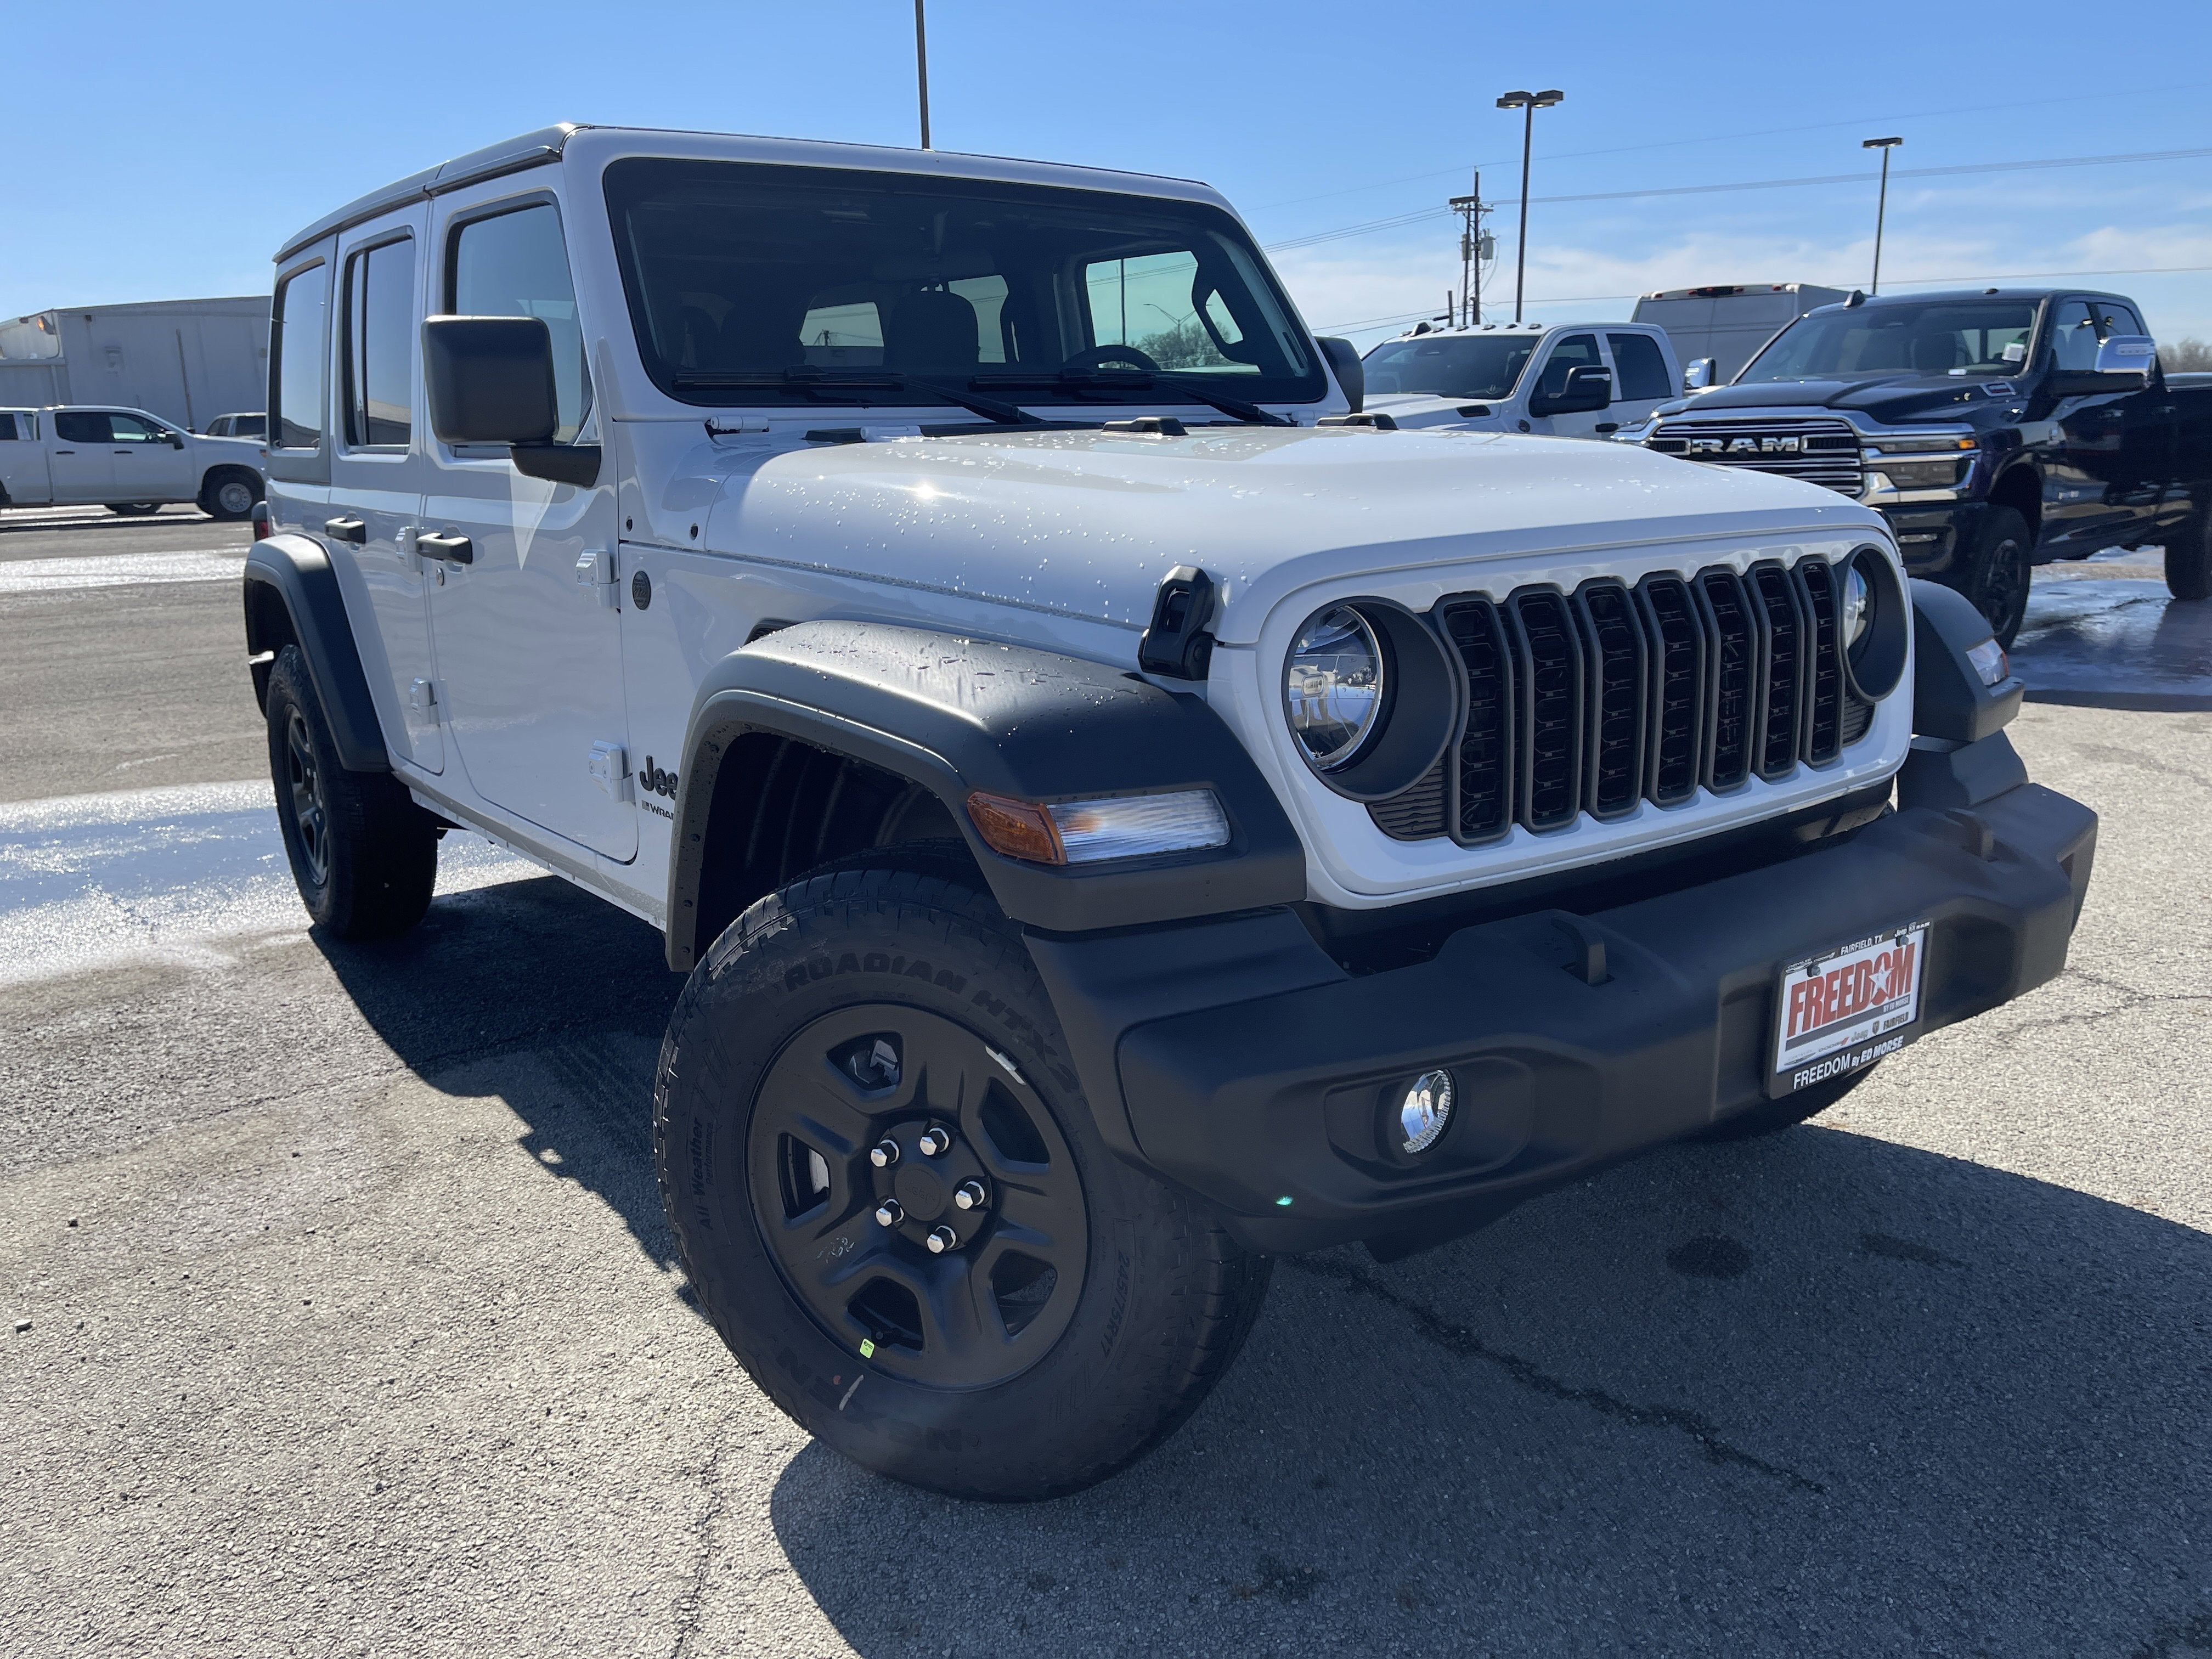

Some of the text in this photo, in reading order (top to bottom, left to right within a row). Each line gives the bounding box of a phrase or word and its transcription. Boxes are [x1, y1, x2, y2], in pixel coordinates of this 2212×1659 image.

[1691, 437, 1799, 453] RAM
[639, 755, 679, 801] Jee
[650, 803, 674, 821] WRA
[1874, 934, 1883, 945] TX
[1787, 942, 1916, 1038] FREEDOM
[1851, 1029, 1869, 1042] Jeep
[1793, 1053, 1851, 1090] FREEDOM
[1860, 1048, 1872, 1063] ED
[1872, 1035, 1904, 1058] MORSE
[690, 1116, 713, 1231] All-Weather
[704, 1122, 714, 1186] Performance
[1101, 1249, 1130, 1358] 245/75R17
